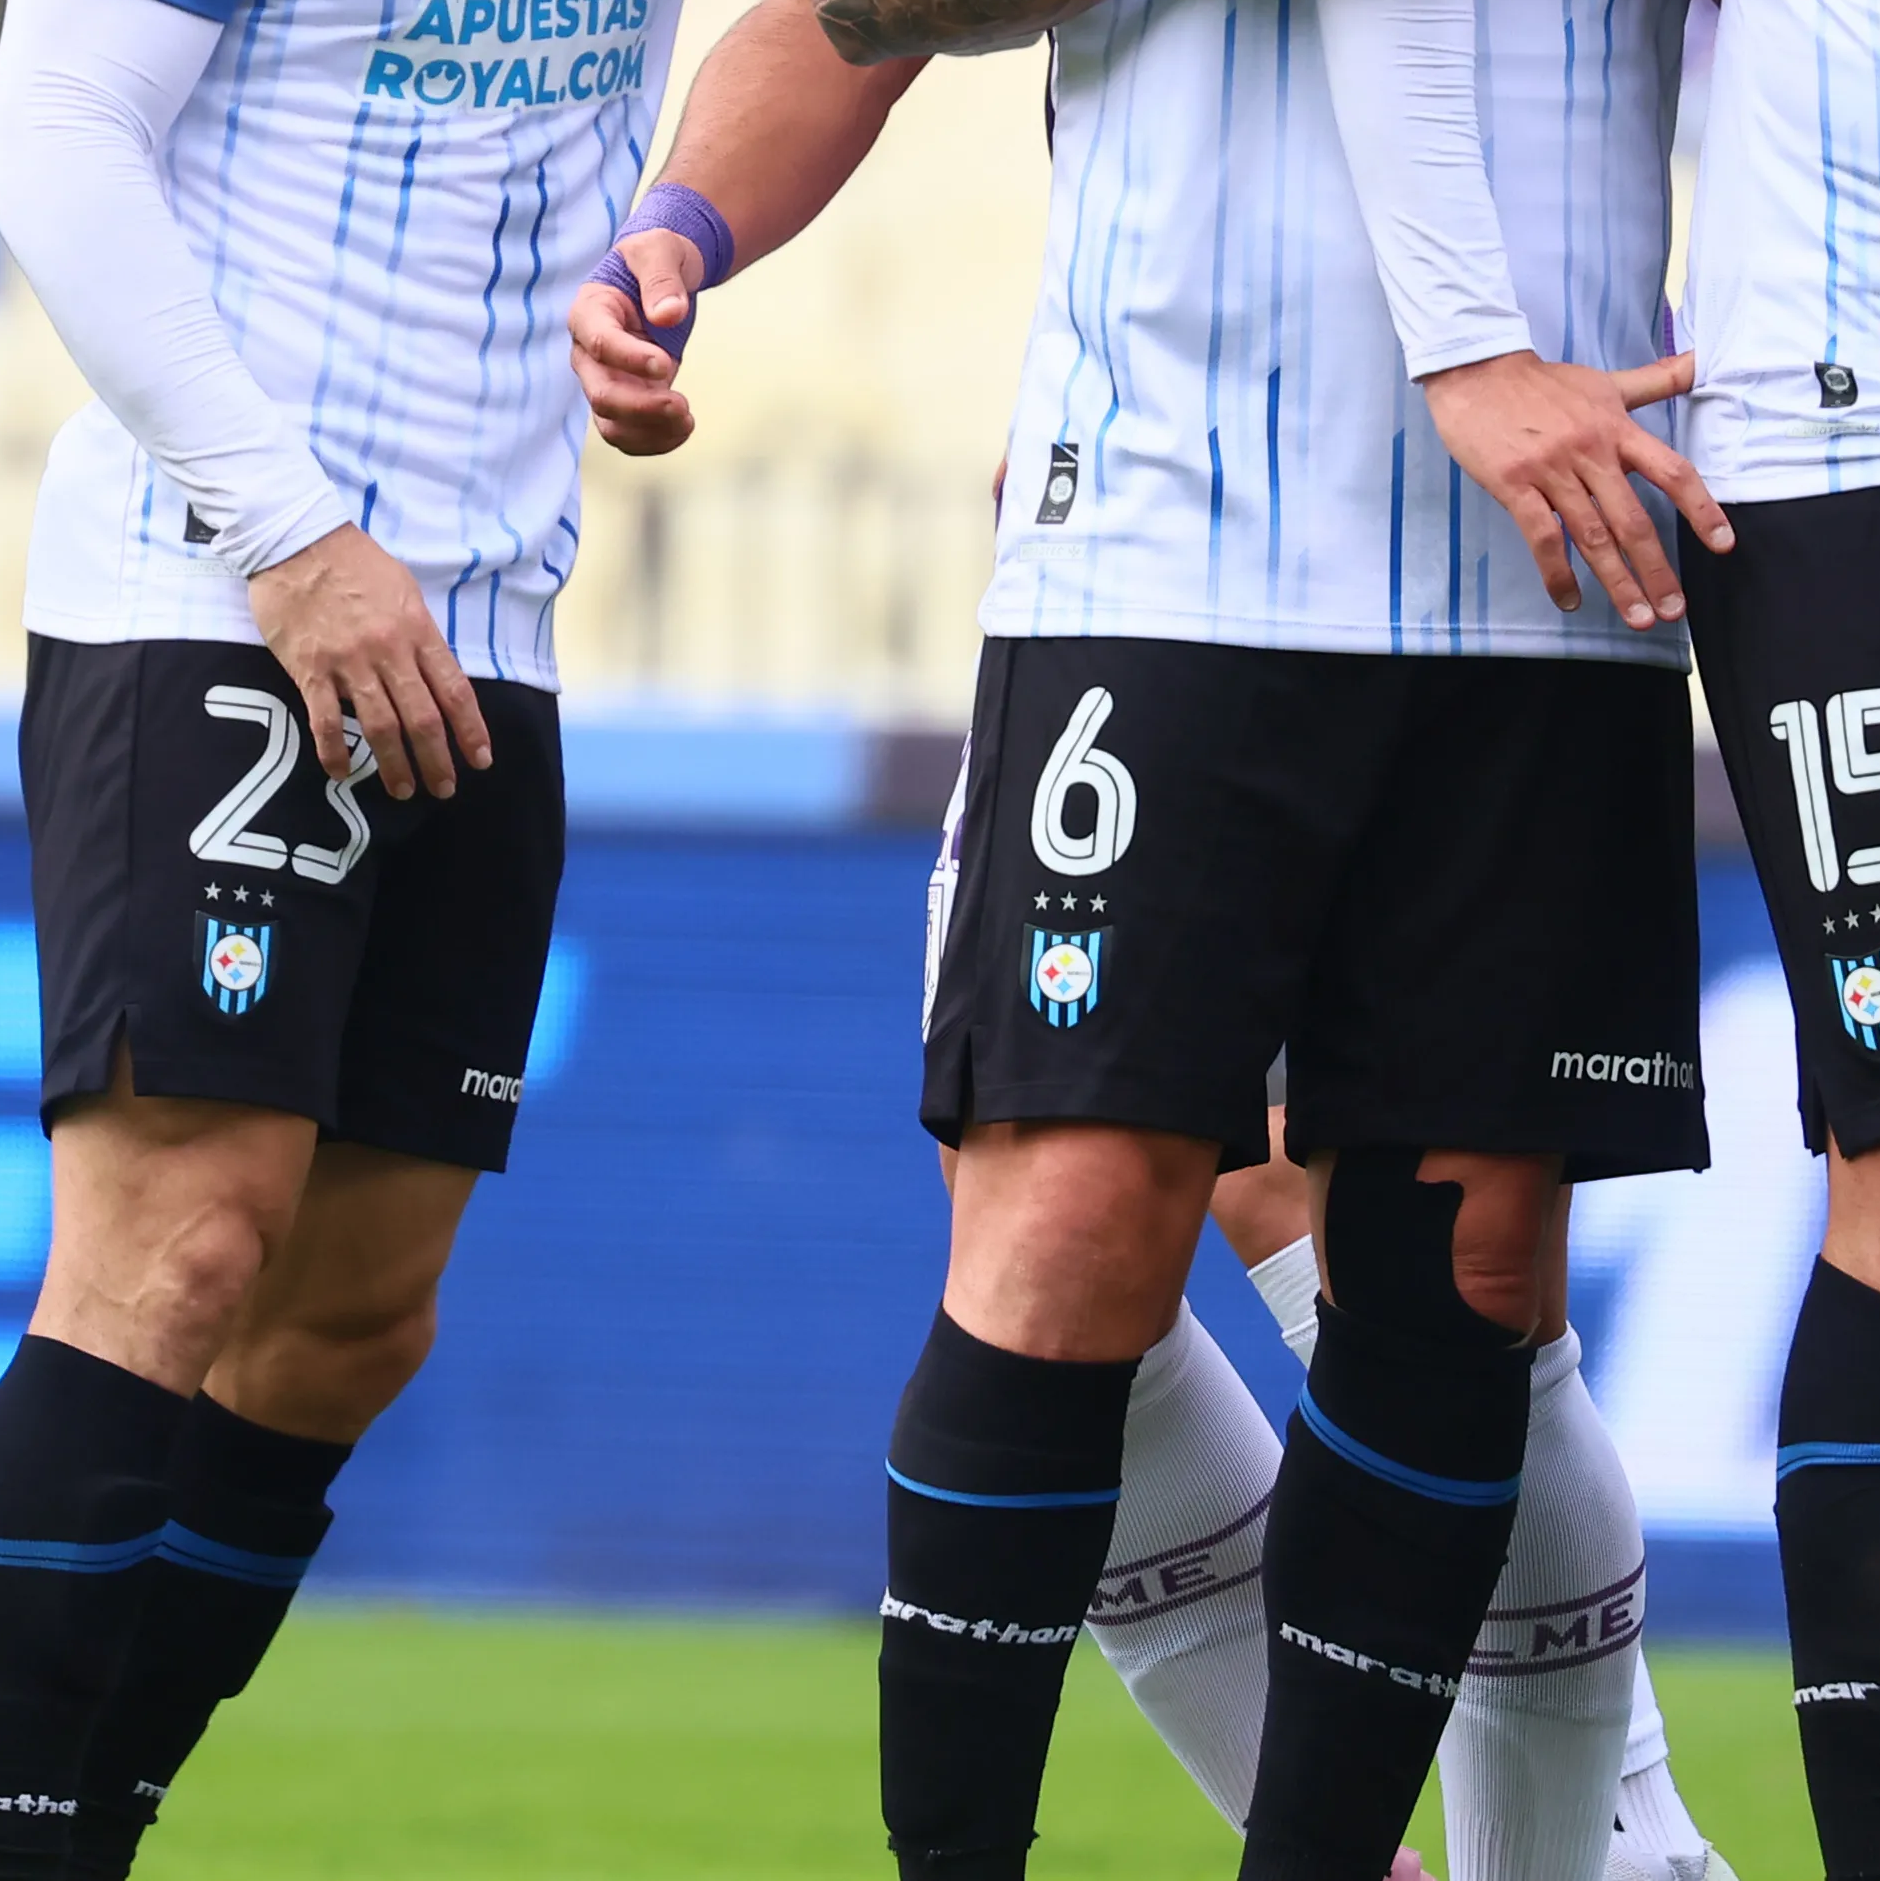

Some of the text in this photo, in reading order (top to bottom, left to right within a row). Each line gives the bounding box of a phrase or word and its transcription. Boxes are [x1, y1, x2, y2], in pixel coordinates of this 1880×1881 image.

[362, 39, 644, 110] ROYAL.COM
[188, 684, 381, 885] 23
[1030, 685, 1138, 877] 6
